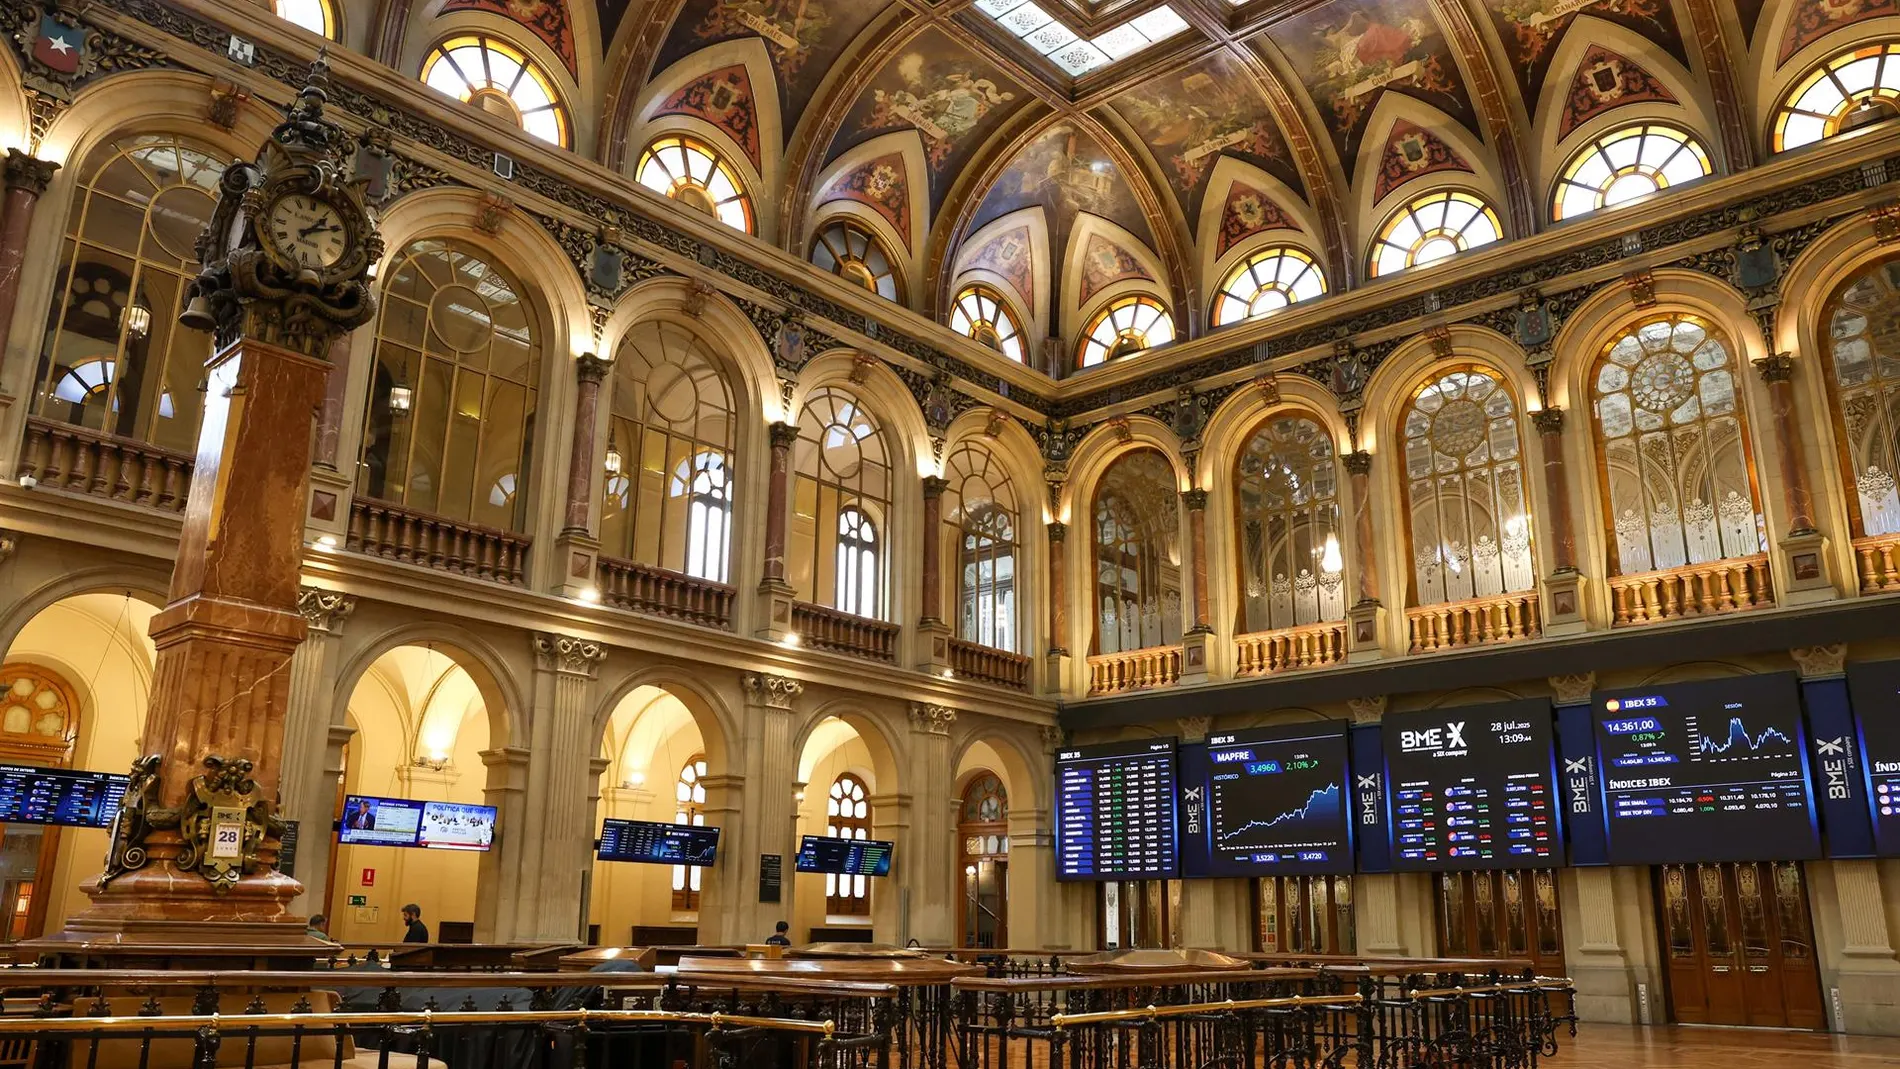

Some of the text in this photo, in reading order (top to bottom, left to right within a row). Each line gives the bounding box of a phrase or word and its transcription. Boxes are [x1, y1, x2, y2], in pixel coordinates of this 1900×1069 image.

[748, 17, 782, 40] BALEARES
[1625, 699, 1644, 708] IBEX
[1490, 723, 1502, 731] 28
[1608, 720, 1654, 732] 14.361,00
[1401, 728, 1442, 748] BME
[1632, 733, 1655, 741] 0,87%
[1217, 751, 1249, 762] MAPFRE
[1250, 761, 1308, 773] 3,4960 2,10%
[1609, 778, 1671, 789] ÍNDICES IBEX
[1824, 760, 1846, 799] BME
[1570, 777, 1587, 813] BME
[433, 804, 460, 812] POLÍTICA
[1361, 792, 1375, 824] BME
[1188, 804, 1198, 833] BME
[219, 831, 237, 842] 28
